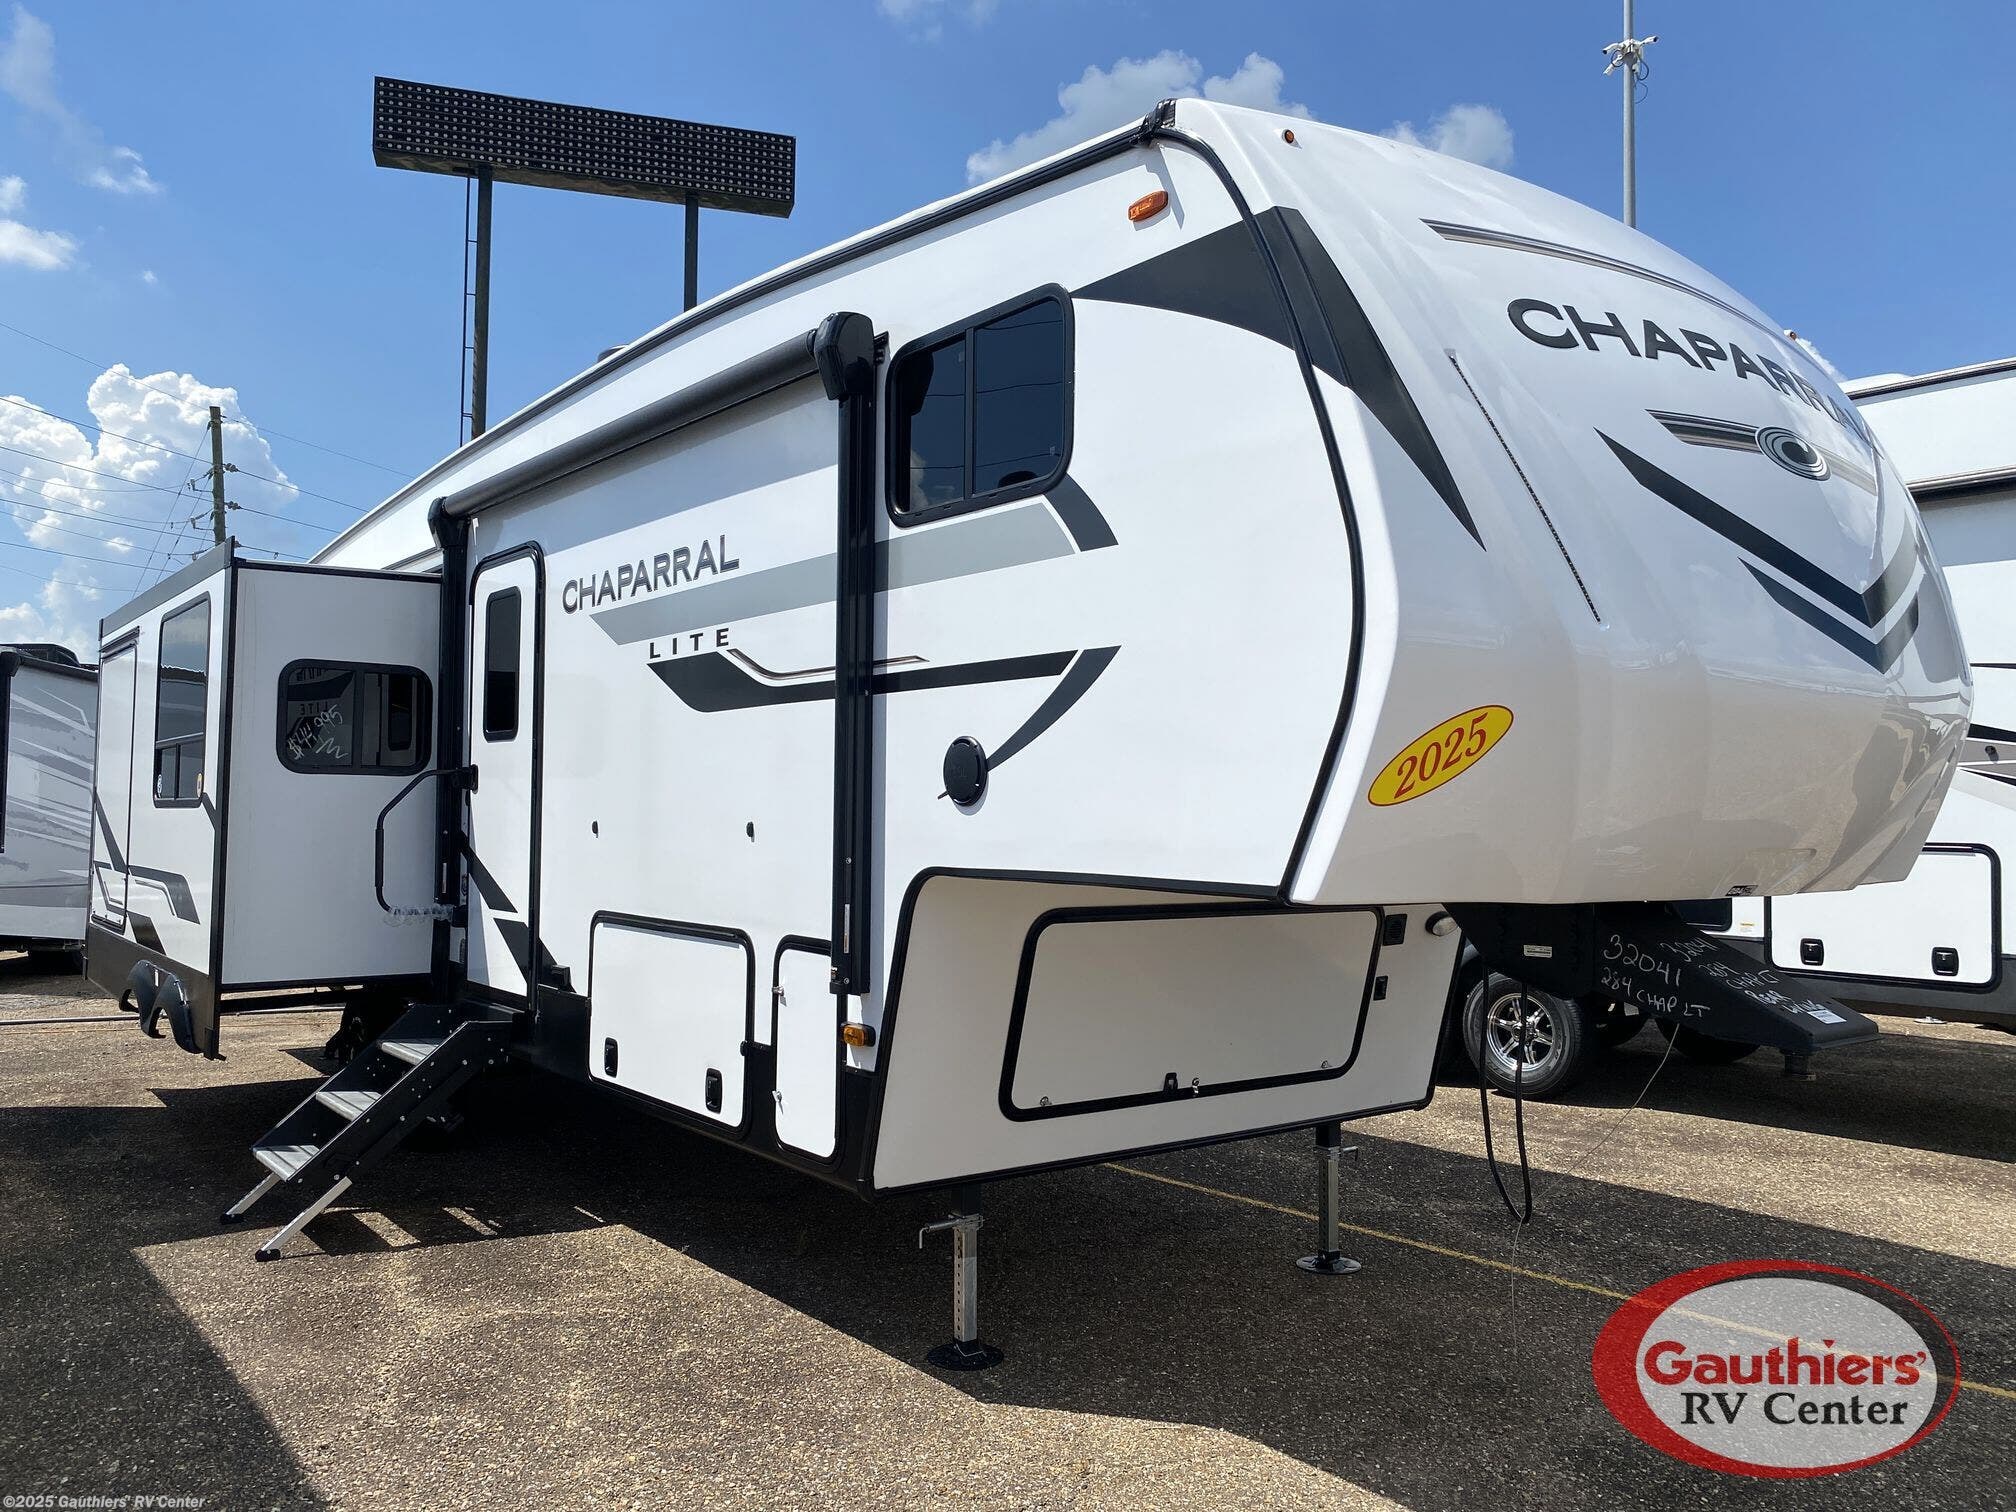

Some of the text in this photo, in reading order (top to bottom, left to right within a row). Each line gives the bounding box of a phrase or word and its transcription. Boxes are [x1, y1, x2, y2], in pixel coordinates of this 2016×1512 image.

[562, 534, 740, 615] CHAPARRAL
[649, 628, 730, 660] LITE
[1394, 712, 1488, 799] 2025
[1603, 934, 1682, 987] 32041
[1601, 967, 1711, 1018] 284 CHAP LT
